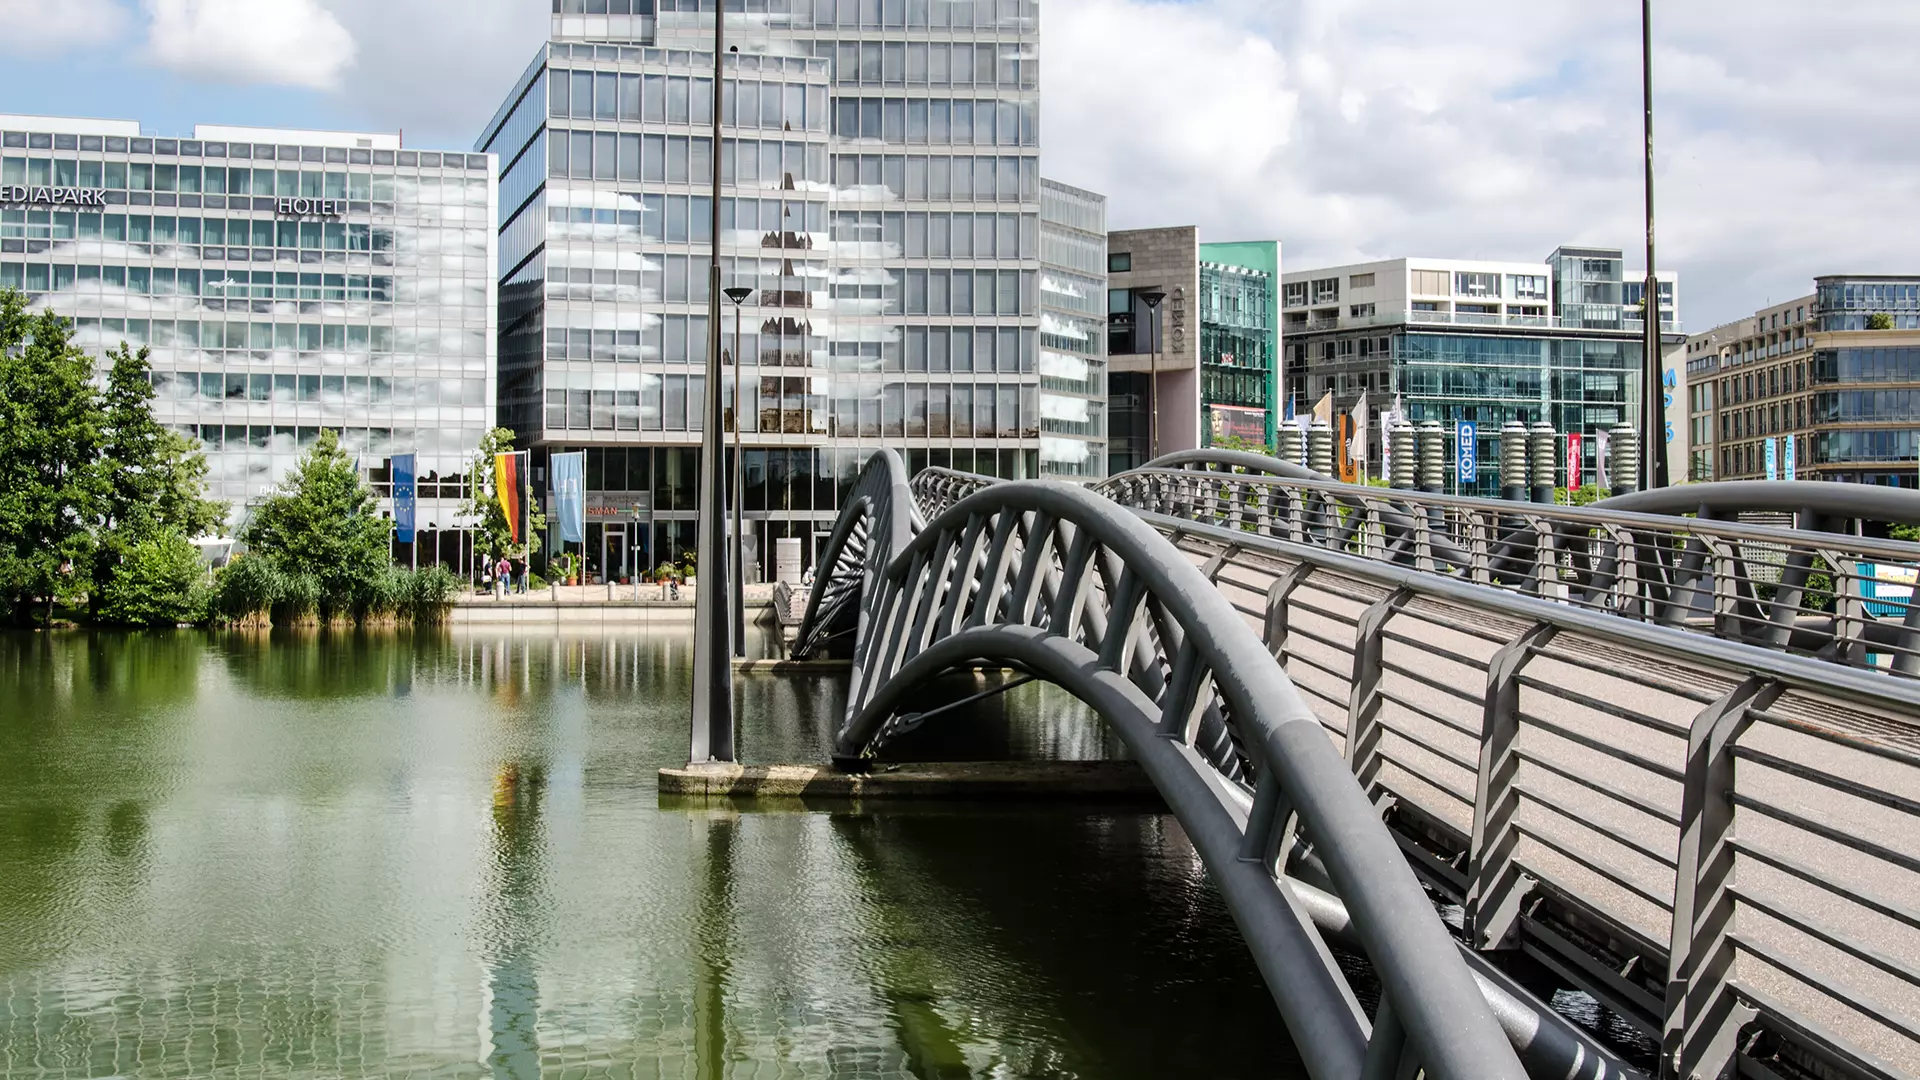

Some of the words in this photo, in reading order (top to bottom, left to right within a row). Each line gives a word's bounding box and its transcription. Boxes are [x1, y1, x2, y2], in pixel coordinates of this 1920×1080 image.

[278, 198, 343, 215] HOTEL
[1171, 284, 1185, 354] KOMED
[1461, 424, 1473, 479] KOMED
[585, 506, 618, 516] SMAN
